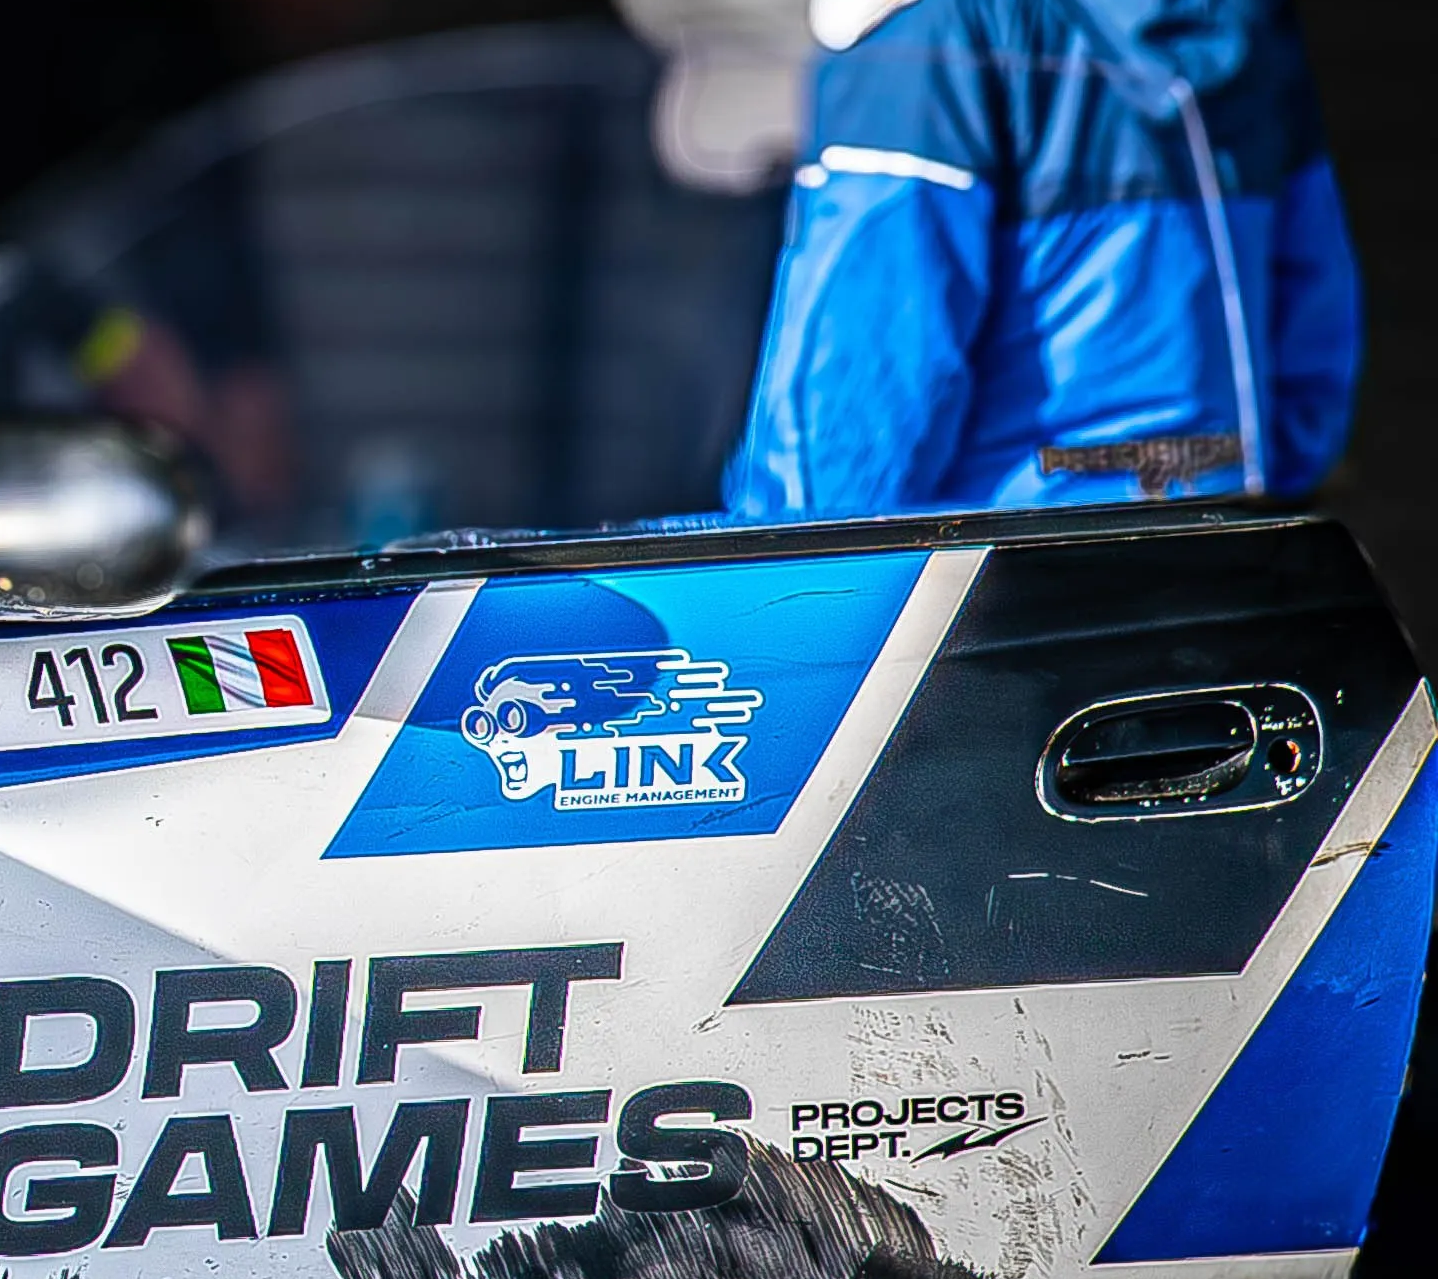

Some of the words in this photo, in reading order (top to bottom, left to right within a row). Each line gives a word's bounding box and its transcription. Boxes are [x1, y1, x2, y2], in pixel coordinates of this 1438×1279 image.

[27, 643, 158, 728] 412
[559, 740, 740, 791] LINK
[560, 793, 620, 806] ENGINE
[625, 787, 740, 802] MANAGEMENT
[791, 1092, 1025, 1131] PROJECTS
[792, 1131, 911, 1163] DEPT.
